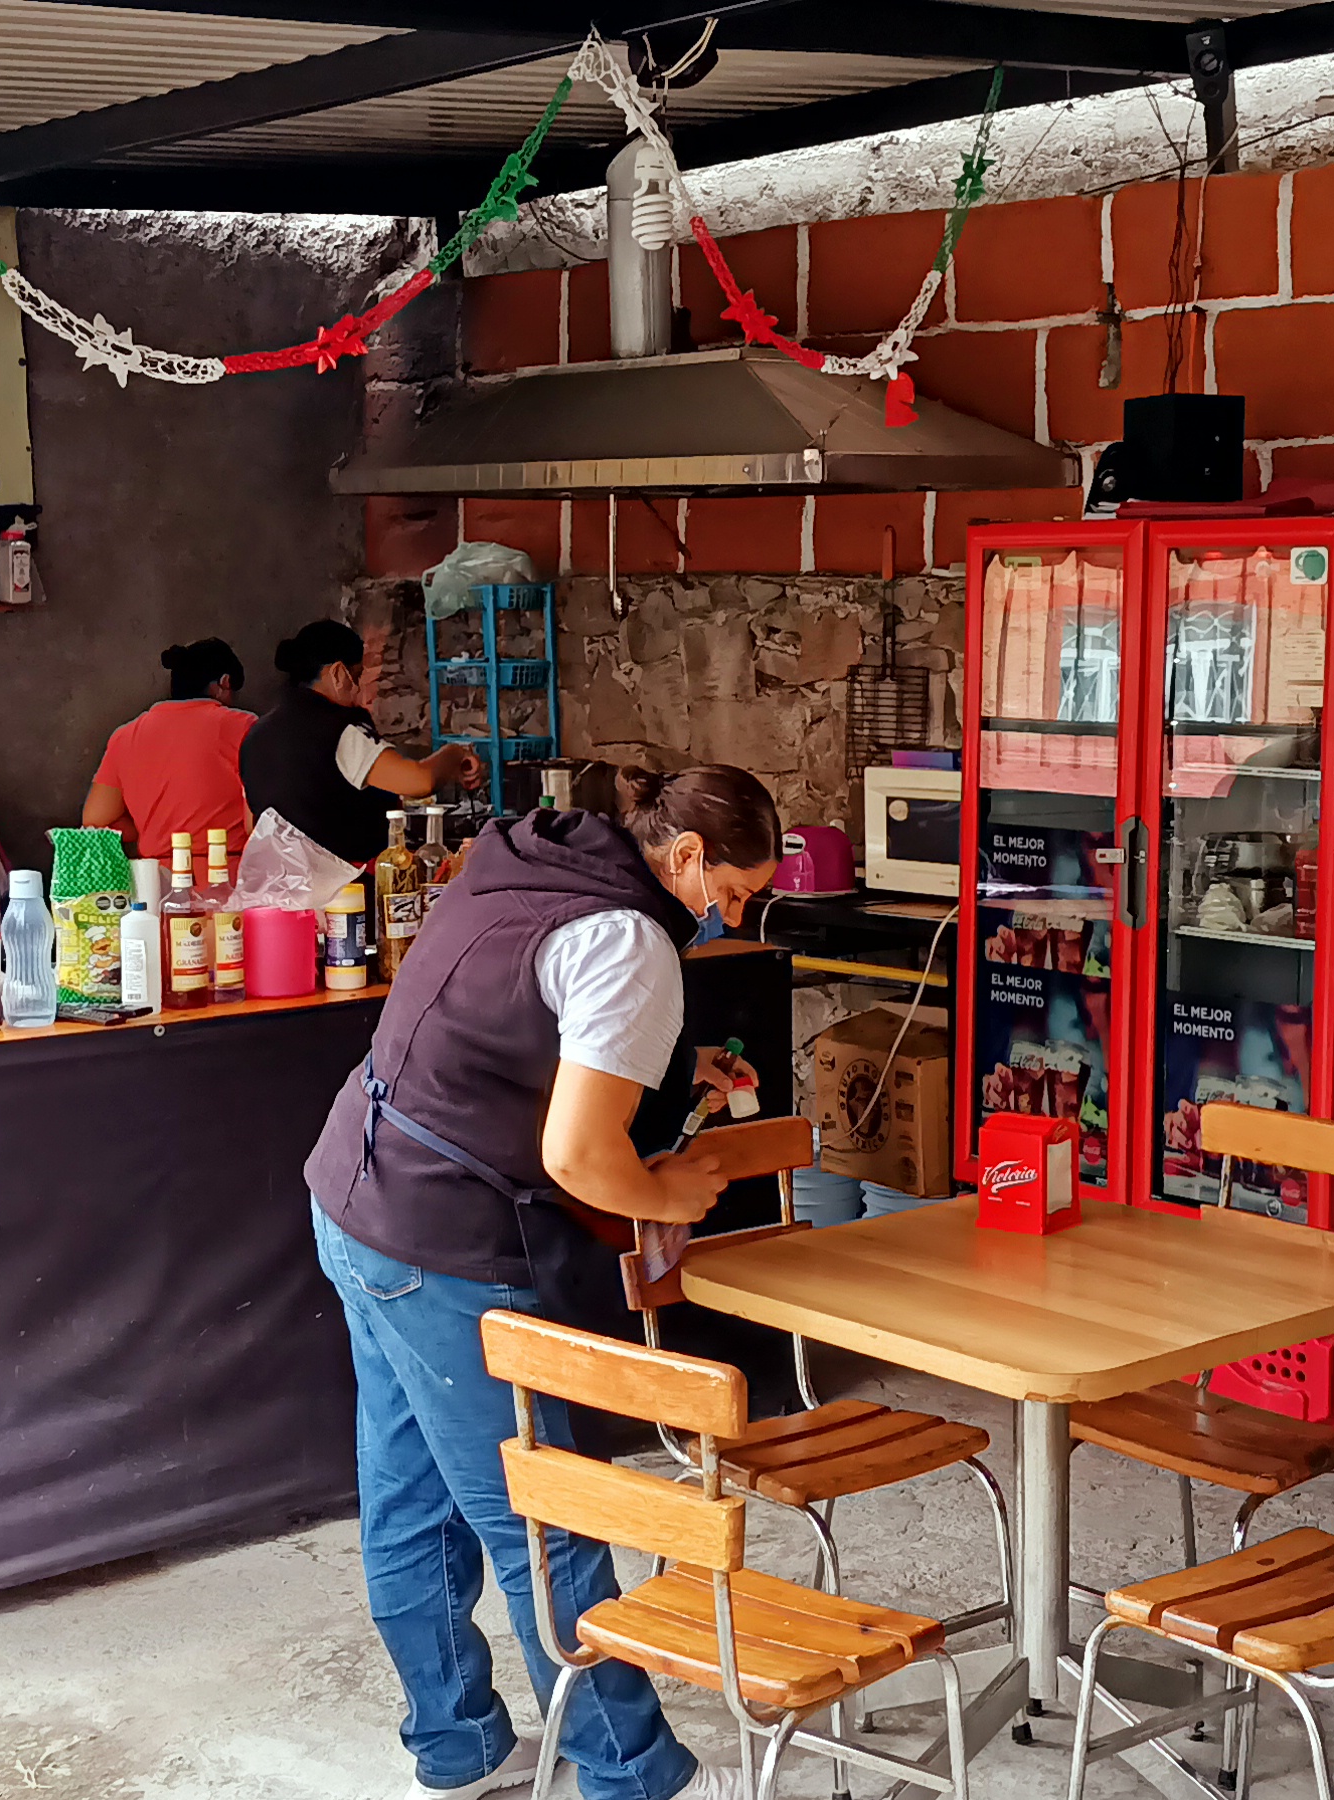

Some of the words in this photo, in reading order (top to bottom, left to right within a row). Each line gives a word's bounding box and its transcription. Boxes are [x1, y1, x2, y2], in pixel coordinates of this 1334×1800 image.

[993, 835, 1006, 847] EL
[1008, 836, 1045, 850] MEJOR
[993, 852, 1047, 868] MOMENTO
[78, 913, 120, 925] DELIC
[991, 973, 1004, 986] EL
[1006, 975, 1043, 991] MEJOR
[990, 990, 1045, 1008] MOMENTO
[1173, 1003, 1188, 1017] EL
[1190, 1006, 1232, 1023] MEJOR
[1173, 1021, 1235, 1041] MOMENTO
[982, 1160, 1038, 1191] Victoria
